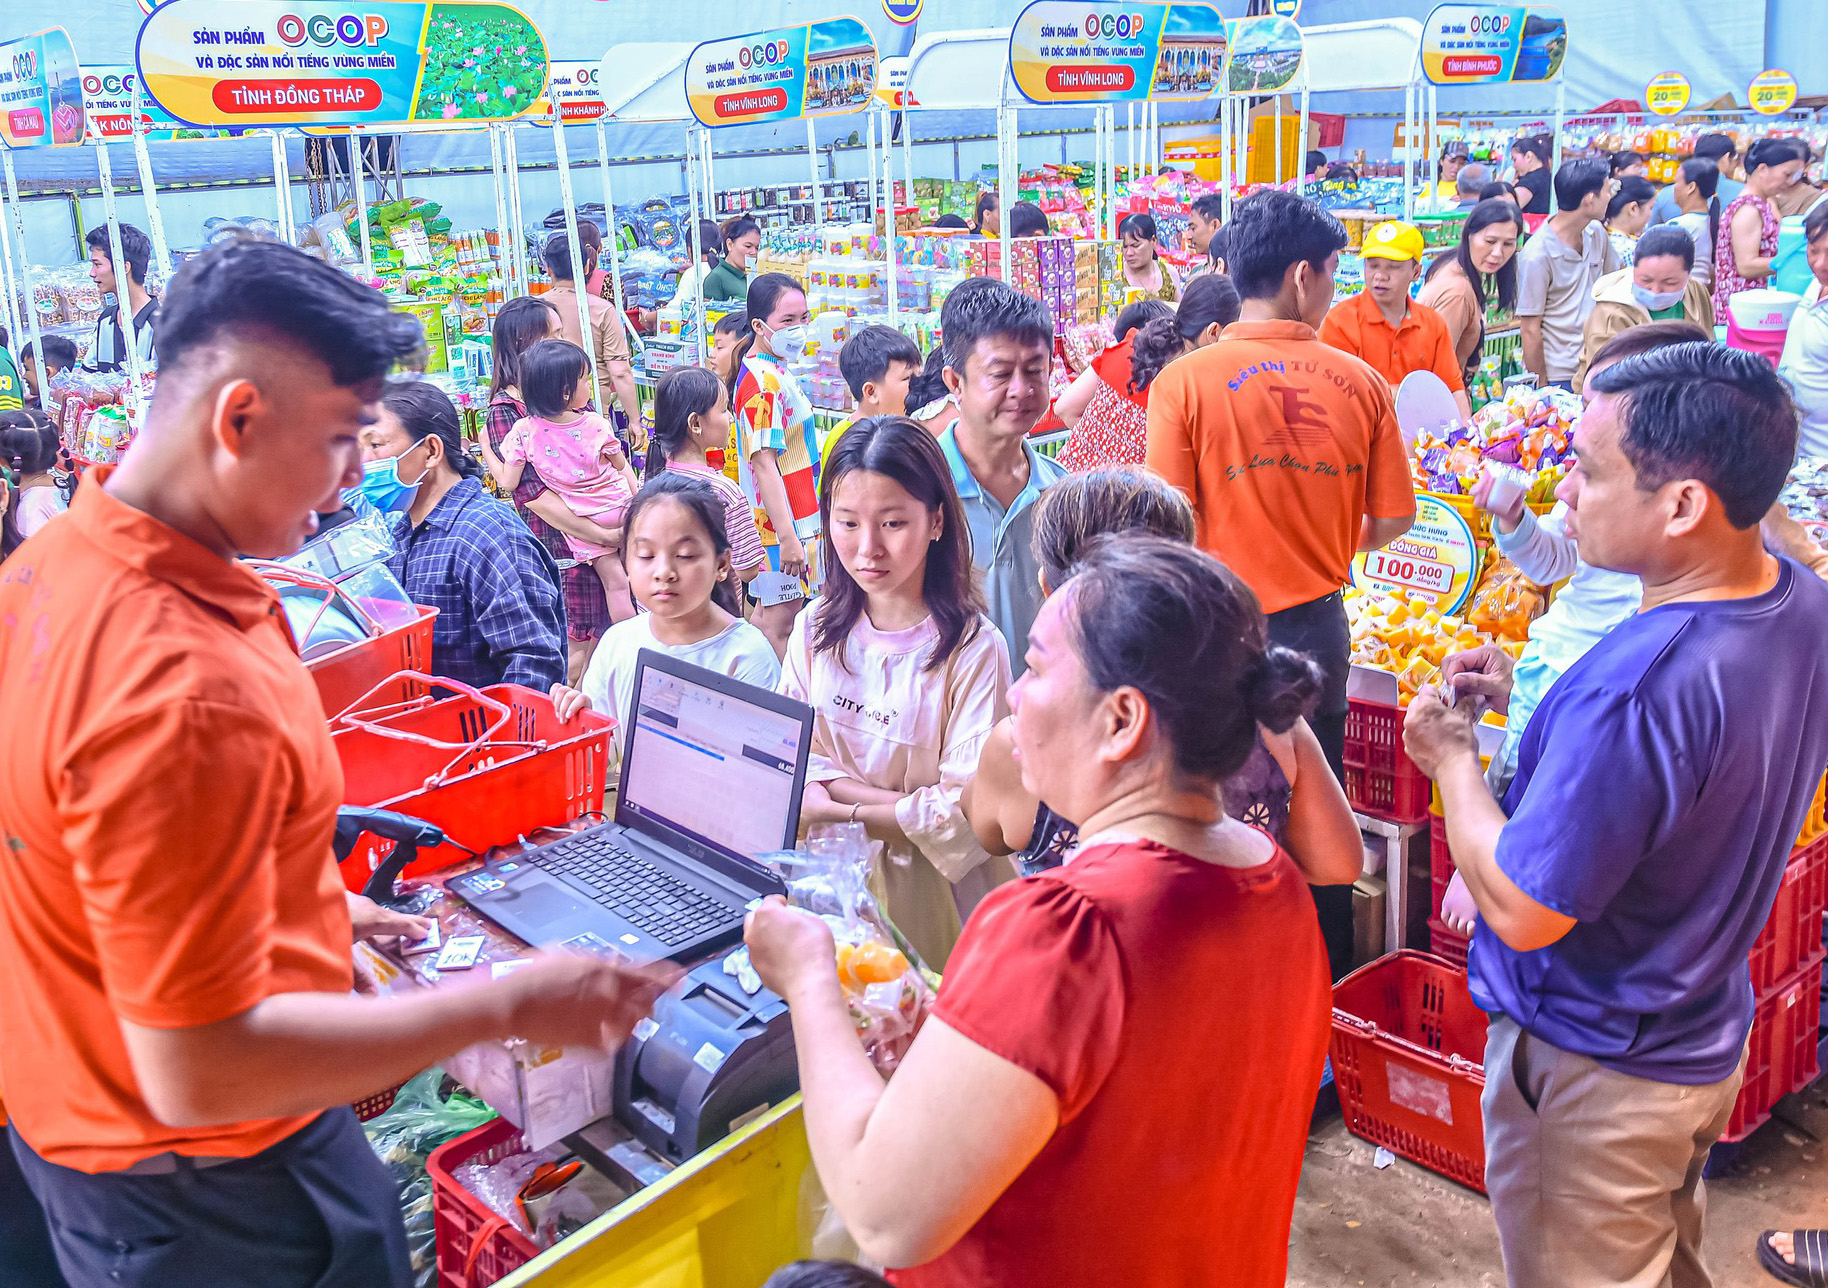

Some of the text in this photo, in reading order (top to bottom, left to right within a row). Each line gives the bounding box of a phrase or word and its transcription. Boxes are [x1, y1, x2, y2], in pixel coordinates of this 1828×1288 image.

[193, 13, 388, 47] SẢN PHẨM OCOP
[1041, 23, 1055, 37] SẢN
[1084, 13, 1144, 40] OCOP
[1471, 15, 1510, 34] OCOP
[196, 51, 396, 71] VÀ ĐẶC SẢN NỔI TIẾNG VÙNG MIỀN
[706, 61, 717, 74] SẢN
[739, 40, 789, 69] OCOP
[1040, 45, 1049, 57] VÀ
[1051, 45, 1064, 59] ĐẶC
[1066, 44, 1078, 57] SẢN
[1093, 44, 1109, 57] TIẾNG
[12, 50, 38, 81] OCOP
[83, 74, 135, 96] OCO
[577, 69, 599, 86] OC
[707, 80, 715, 89] VÀ
[1058, 70, 1124, 86] TỈNH VĨNH LONG
[231, 84, 366, 105] TỈNH ĐỒNG THÁP
[723, 94, 778, 112] TỈNH VĨNH LONG
[110, 115, 133, 132] NÔN
[1228, 365, 1259, 392] Siêu
[1261, 360, 1285, 374] thị
[1419, 545, 1438, 560] GIÁ
[1377, 555, 1443, 580] 100.000
[832, 694, 864, 714] CITY
